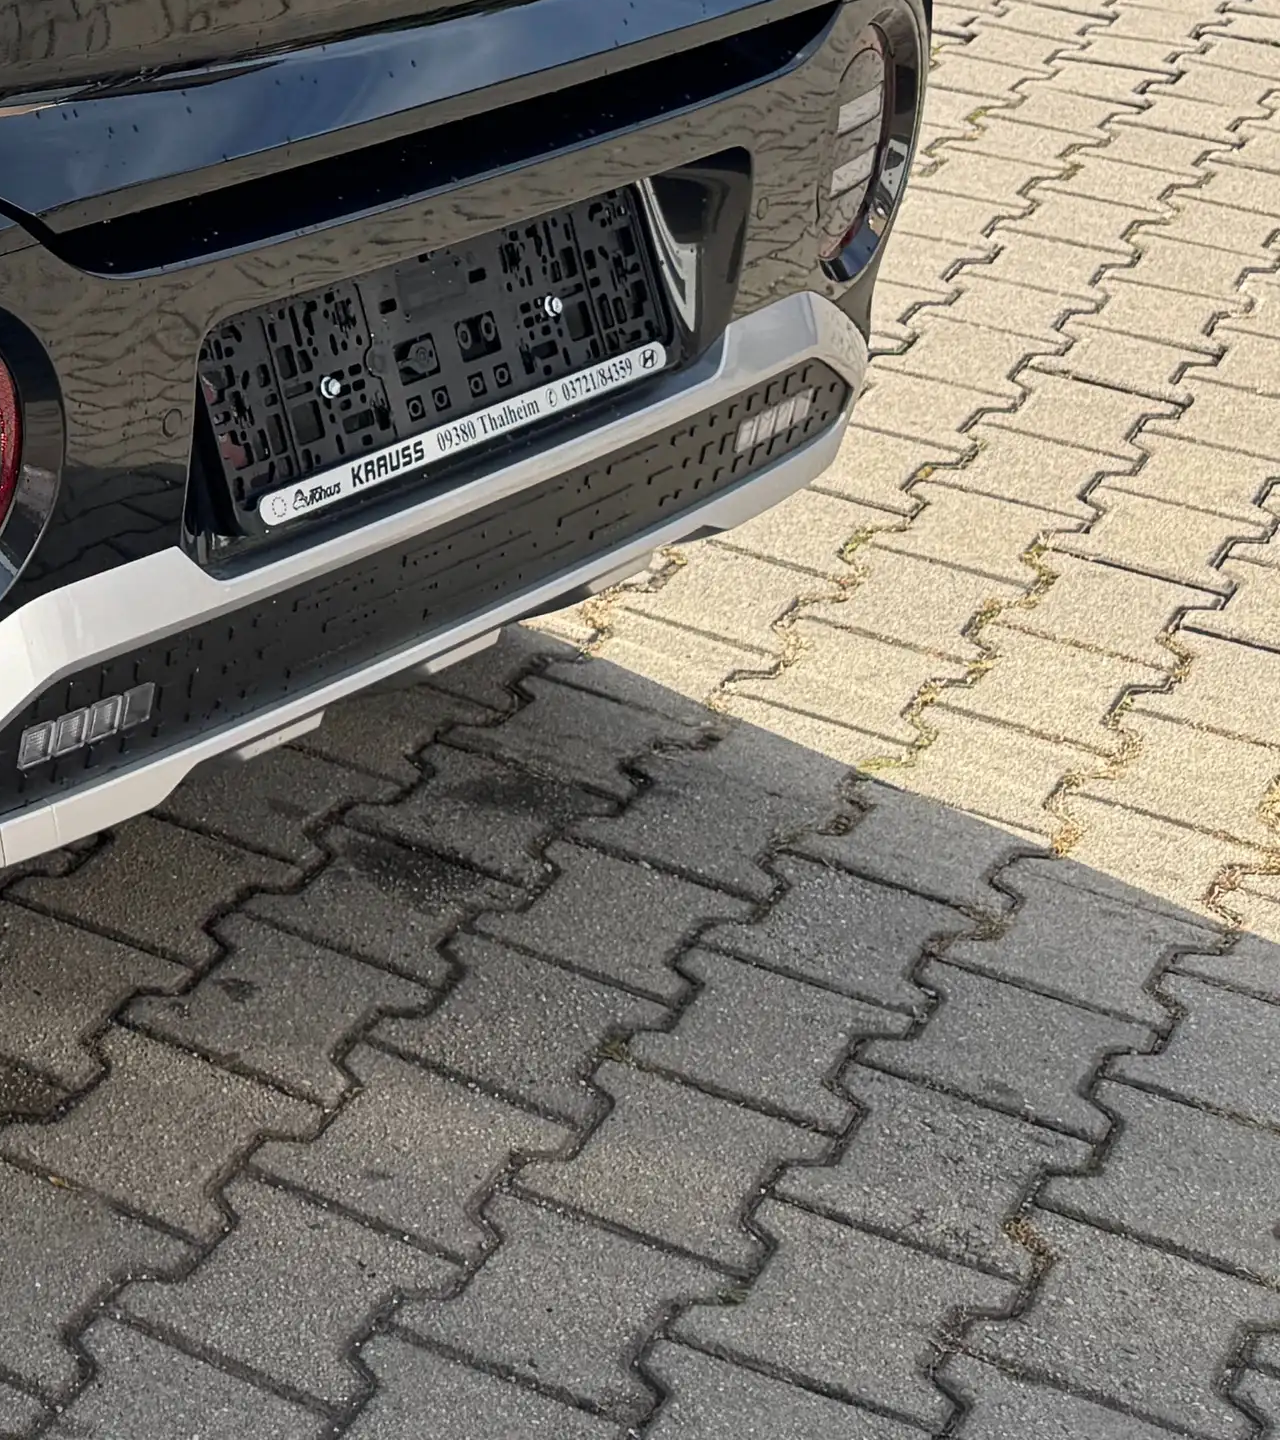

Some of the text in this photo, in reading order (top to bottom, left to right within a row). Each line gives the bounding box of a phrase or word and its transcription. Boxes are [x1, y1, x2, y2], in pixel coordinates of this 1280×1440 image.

[351, 440, 425, 488] KRAUSS
[436, 419, 477, 452] 09380
[478, 399, 540, 435] Thalheim
[561, 357, 633, 403] 03721/84359
